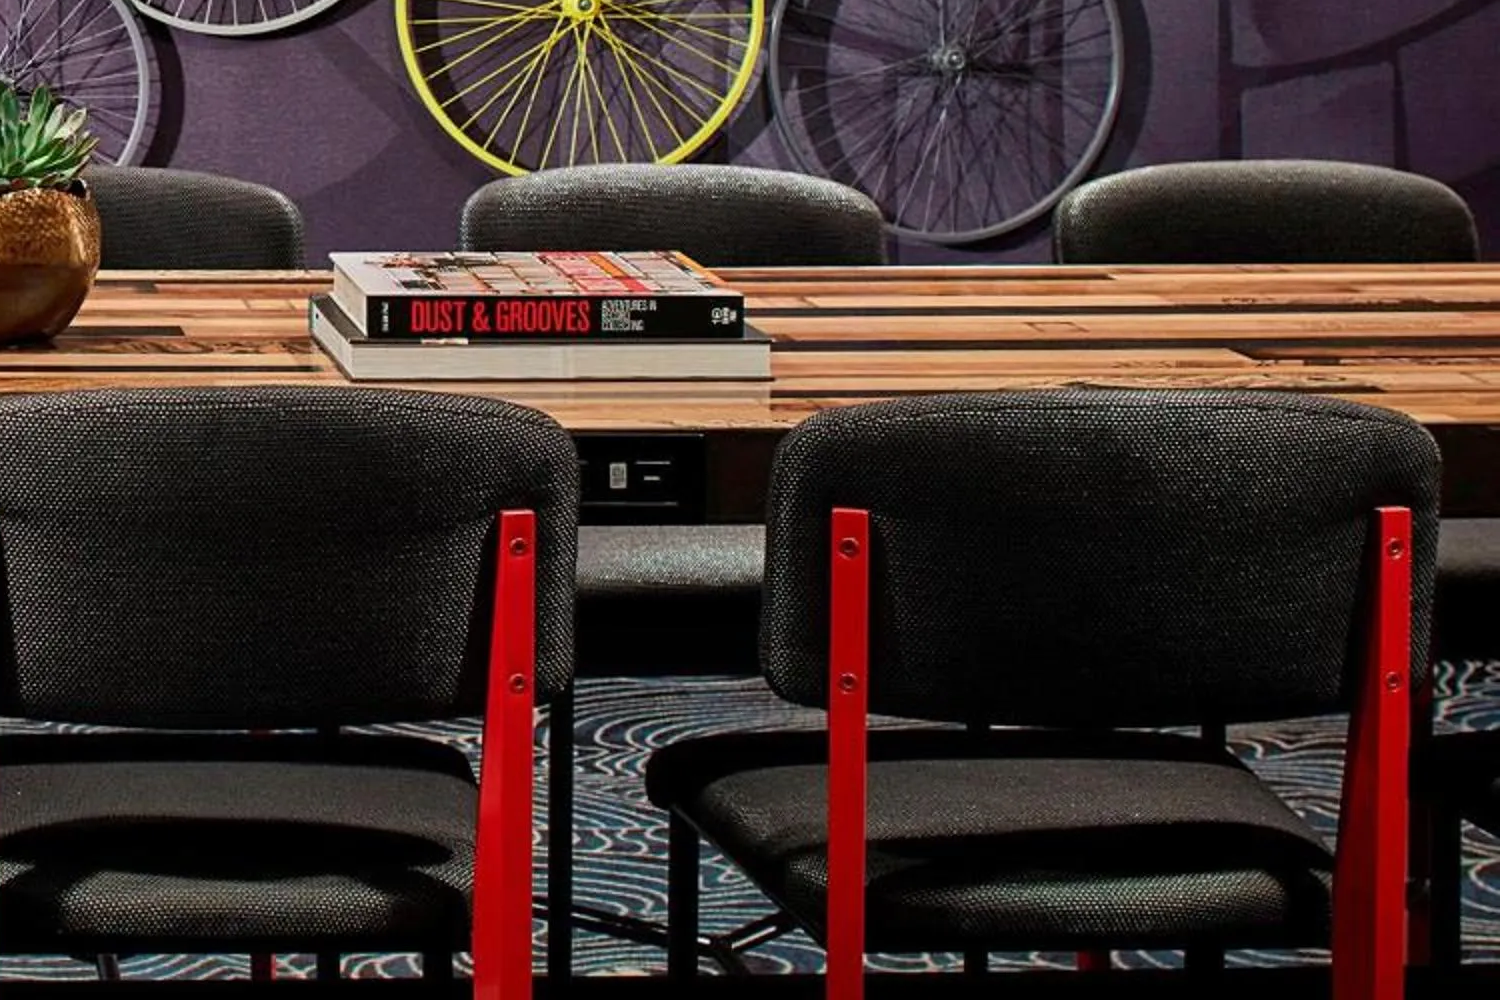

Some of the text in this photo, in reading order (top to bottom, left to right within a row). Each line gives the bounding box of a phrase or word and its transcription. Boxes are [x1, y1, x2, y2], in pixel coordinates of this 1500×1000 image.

[411, 300, 467, 332] DUST
[472, 301, 491, 332] &
[495, 300, 591, 332] GROOVES
